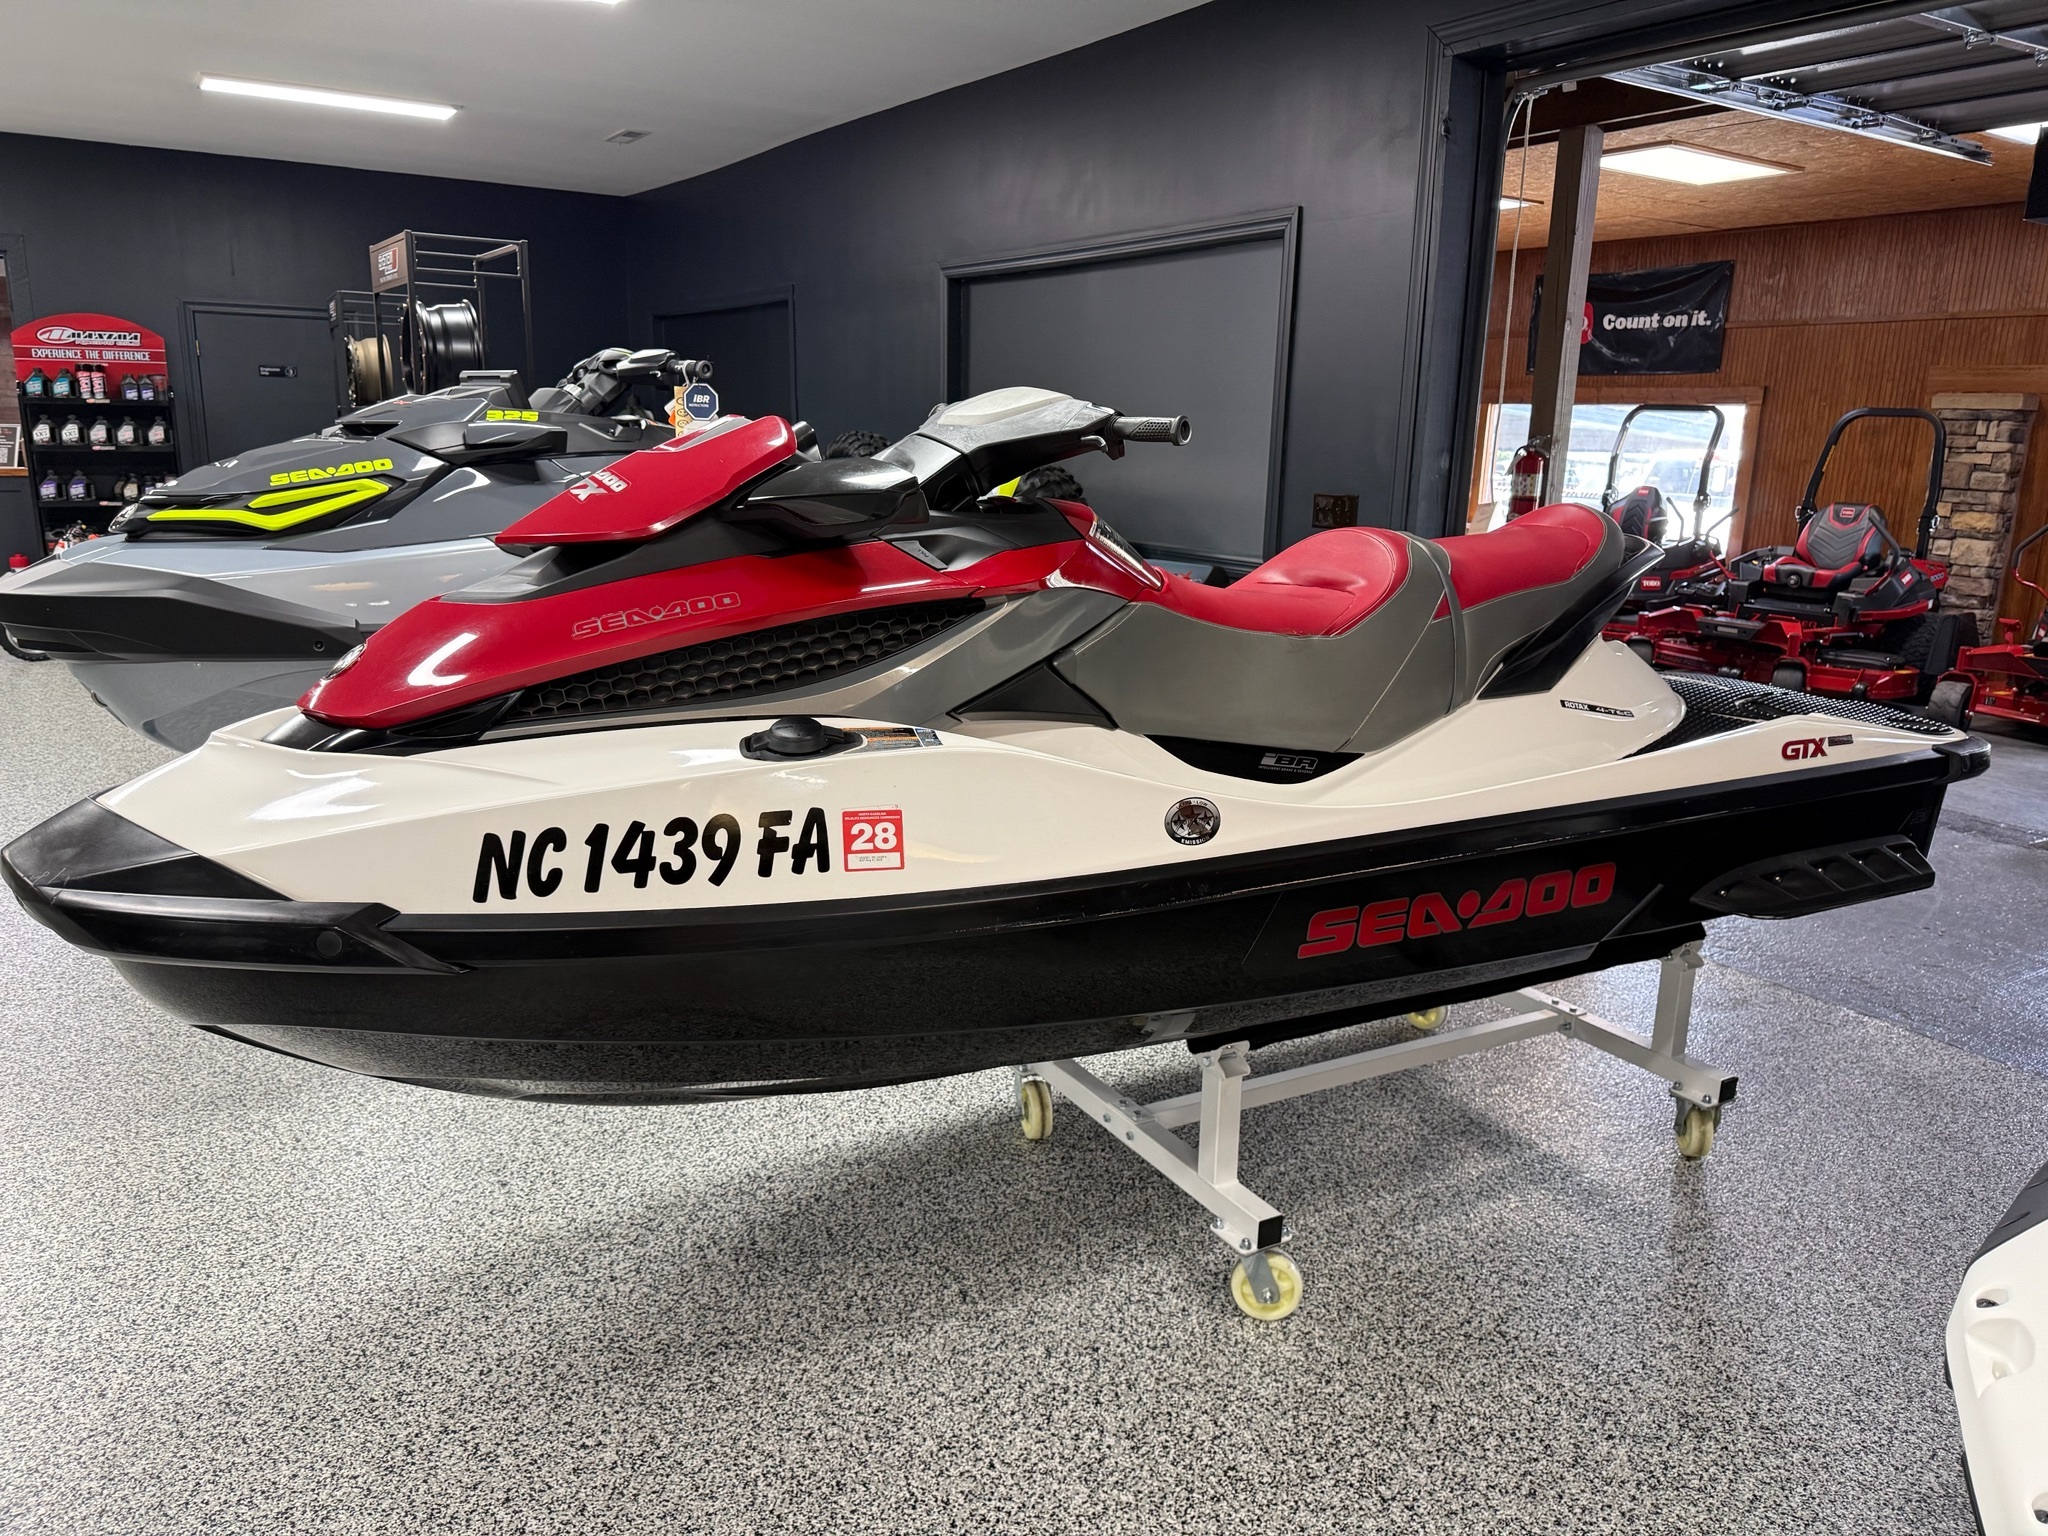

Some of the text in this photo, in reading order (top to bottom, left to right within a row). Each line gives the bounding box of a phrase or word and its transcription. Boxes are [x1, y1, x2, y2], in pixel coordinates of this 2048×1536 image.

[1602, 312, 1660, 330] Count
[1662, 313, 1689, 328] on
[1690, 309, 1712, 327] it.
[31, 348, 151, 361] EXPERIENCE THE DIFFERENCE
[693, 394, 711, 404] IBR
[485, 409, 540, 422] 325
[1642, 579, 1661, 588] TORO
[1564, 701, 1633, 717] ROTAX 4-TEC
[1781, 737, 1828, 761] GTX
[850, 821, 898, 851] 28
[472, 807, 830, 904] NC 1439 FA
